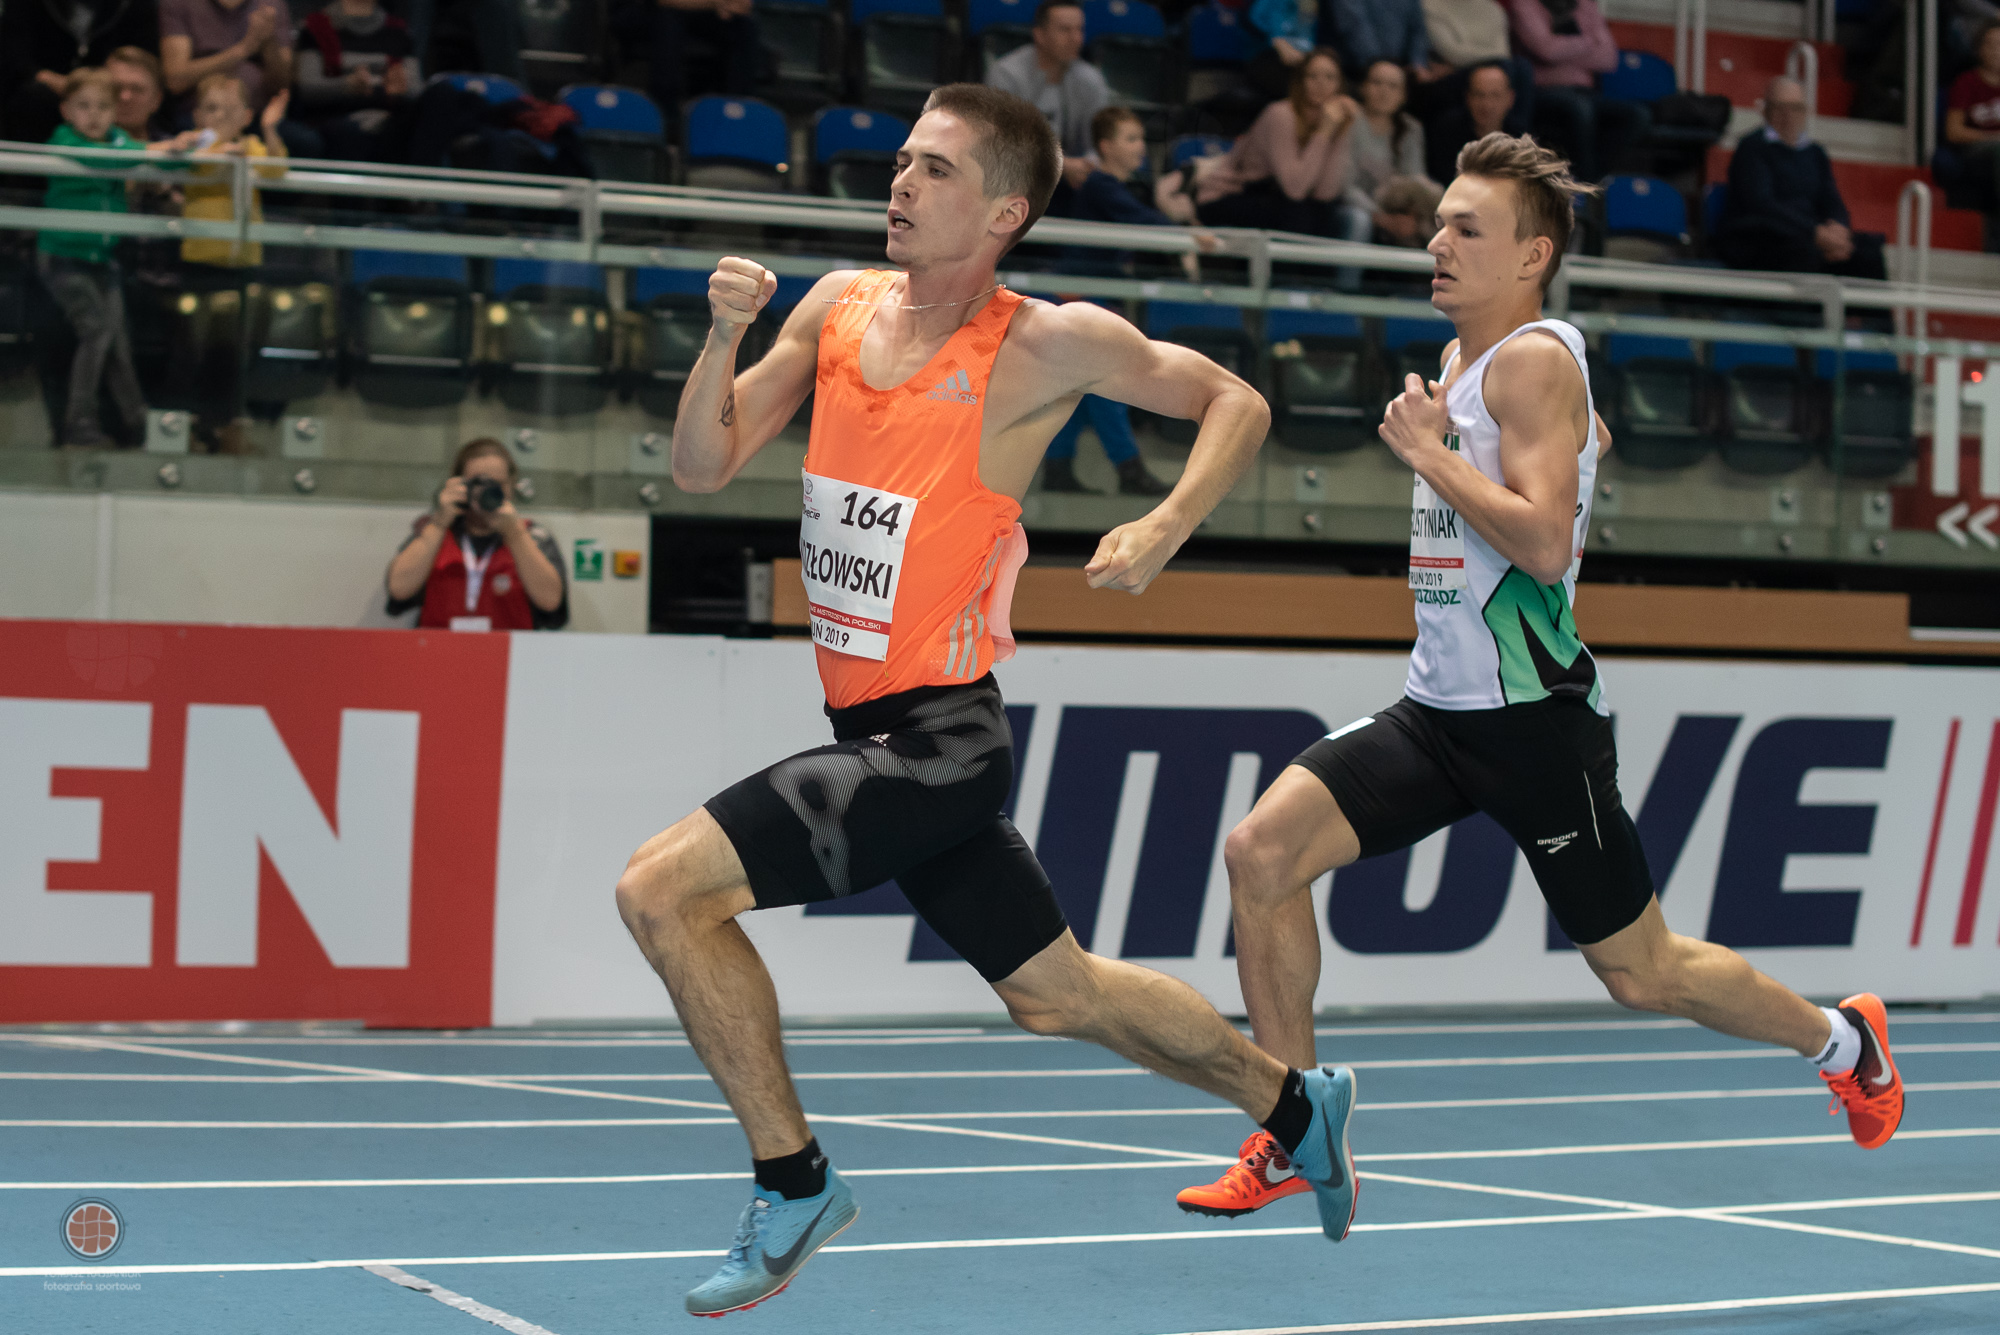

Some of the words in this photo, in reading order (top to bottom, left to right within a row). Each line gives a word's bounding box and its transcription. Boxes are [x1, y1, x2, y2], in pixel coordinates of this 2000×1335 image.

[926, 388, 978, 405] adidas
[840, 491, 903, 536] 164
[1425, 572, 1443, 586] 2019
[852, 618, 881, 630] POLSKI
[825, 626, 850, 648] 2019
[1537, 831, 1578, 845] BROOKS
